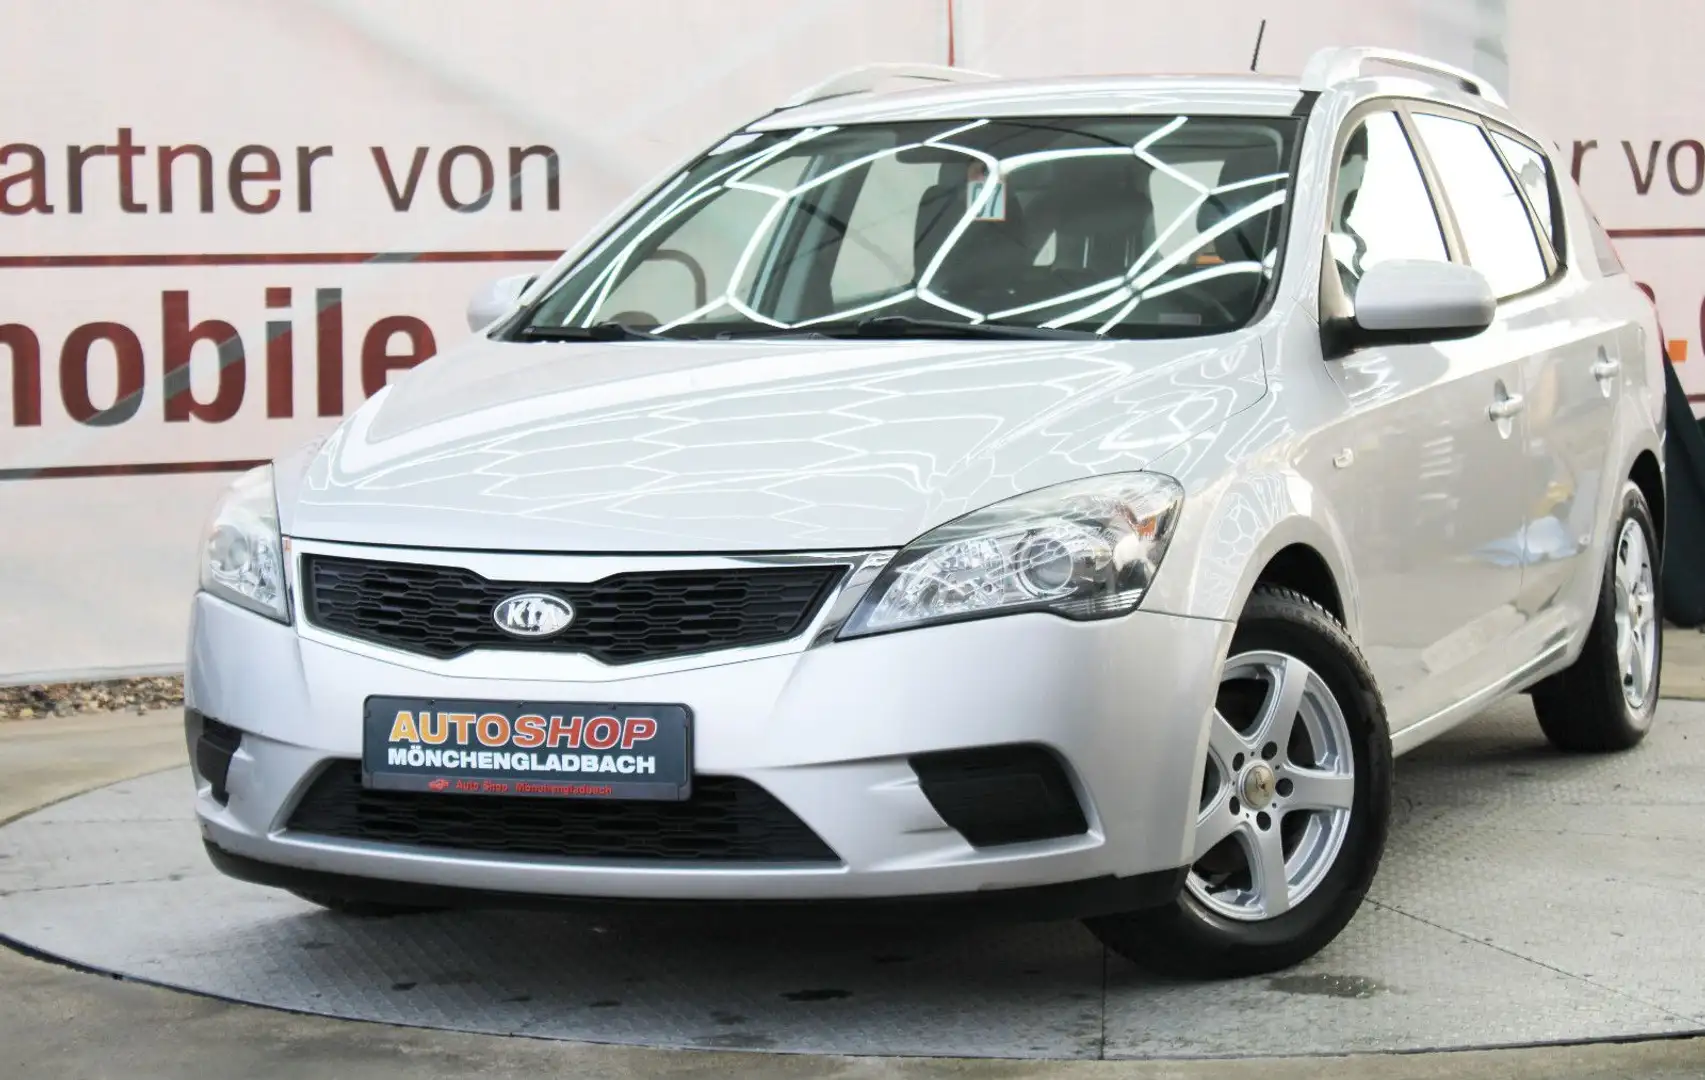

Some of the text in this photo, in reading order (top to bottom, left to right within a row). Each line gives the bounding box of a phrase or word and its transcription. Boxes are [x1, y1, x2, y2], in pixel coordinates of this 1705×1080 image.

[371, 144, 560, 213] von
[504, 597, 568, 631] KIA
[388, 710, 657, 749] AUTOSHOP
[387, 745, 655, 774] MÖNCHENGLADBACH
[455, 779, 479, 792] Auto
